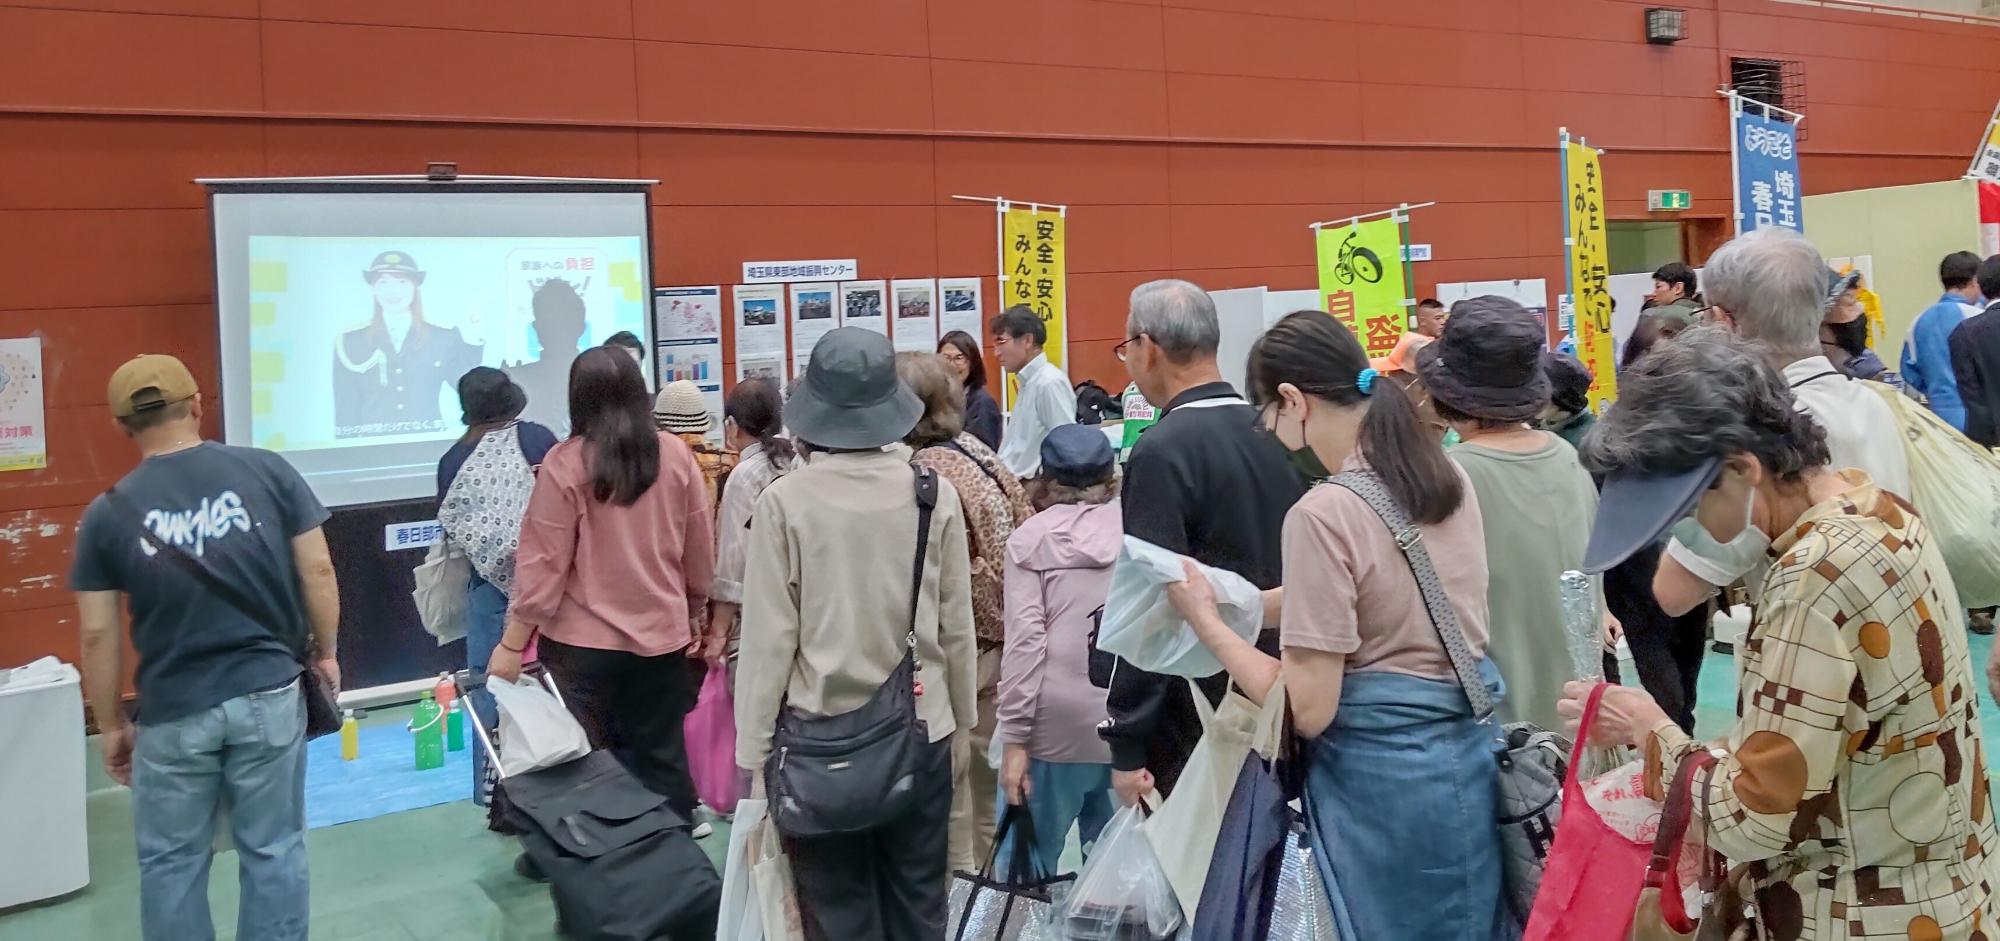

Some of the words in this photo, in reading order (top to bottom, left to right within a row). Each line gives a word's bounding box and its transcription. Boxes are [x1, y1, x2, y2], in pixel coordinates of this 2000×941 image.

[1774, 170, 1796, 227] 埼玉
[747, 264, 853, 278] 埼玉県東部地域振興センター
[1015, 234, 1032, 310] みんな
[1036, 220, 1054, 322] 安全・安心
[0, 425, 33, 439] 対策
